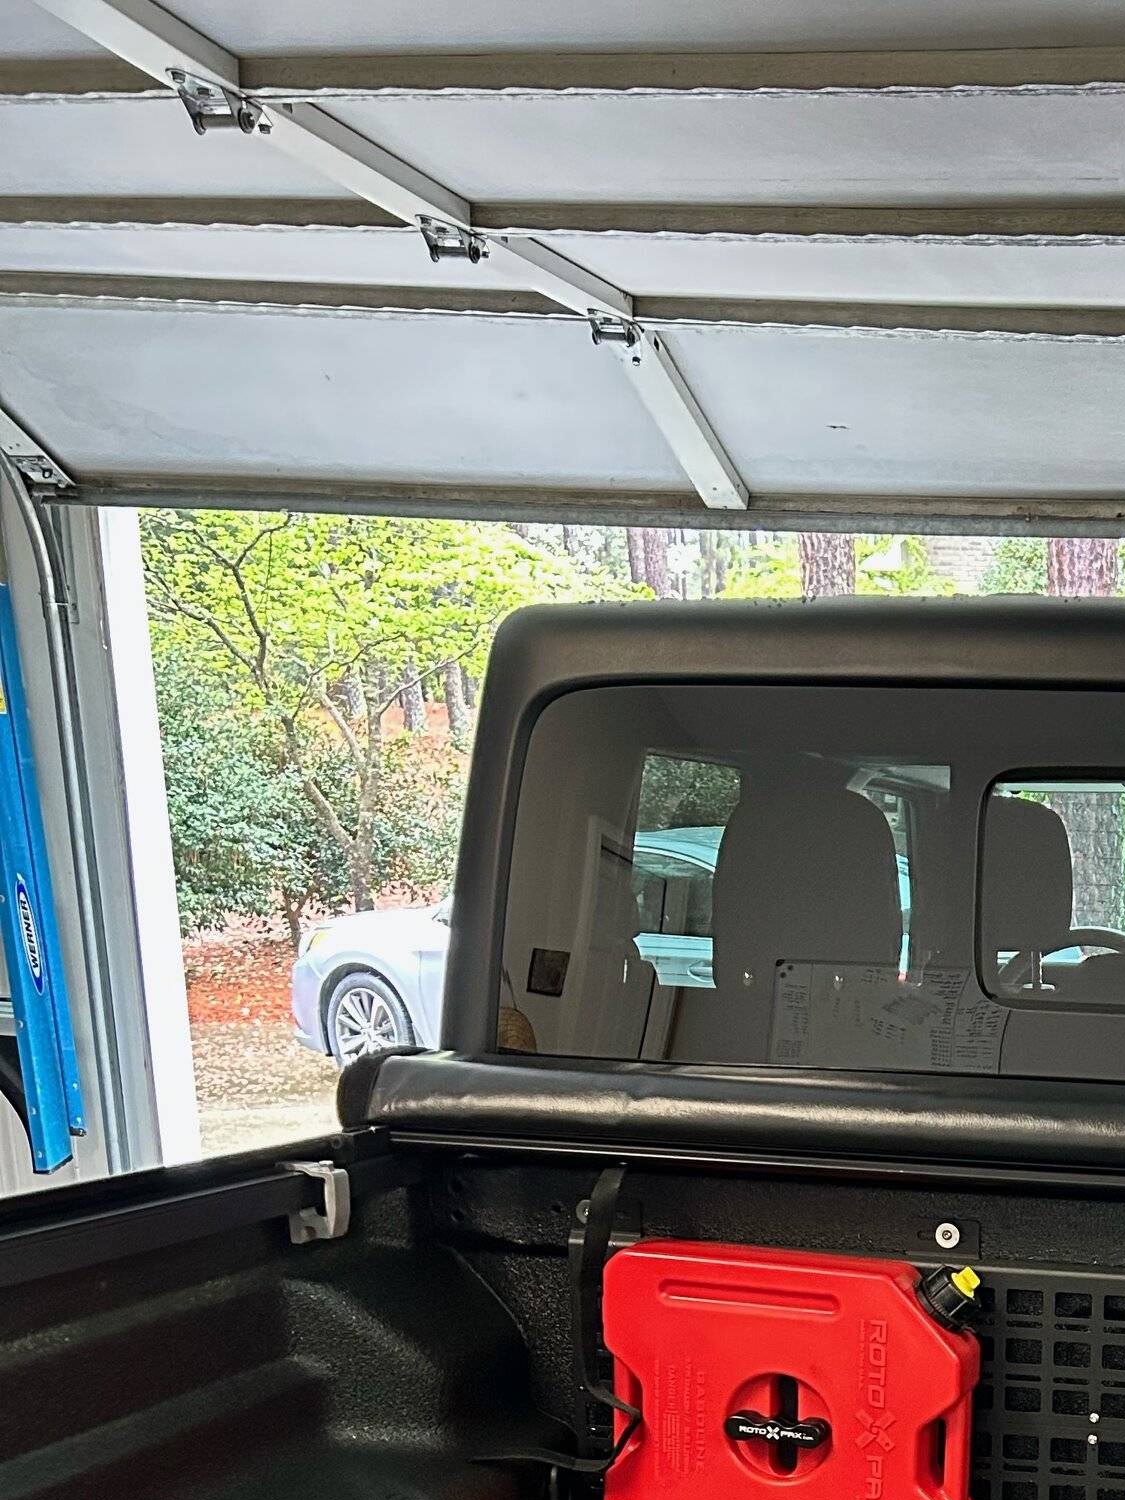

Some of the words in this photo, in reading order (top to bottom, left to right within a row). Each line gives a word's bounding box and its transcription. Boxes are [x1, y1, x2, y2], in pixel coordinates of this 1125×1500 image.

[20, 899, 39, 968] WERNER
[868, 1319, 887, 1409] ROTO
[738, 1425, 767, 1435] ROTO
